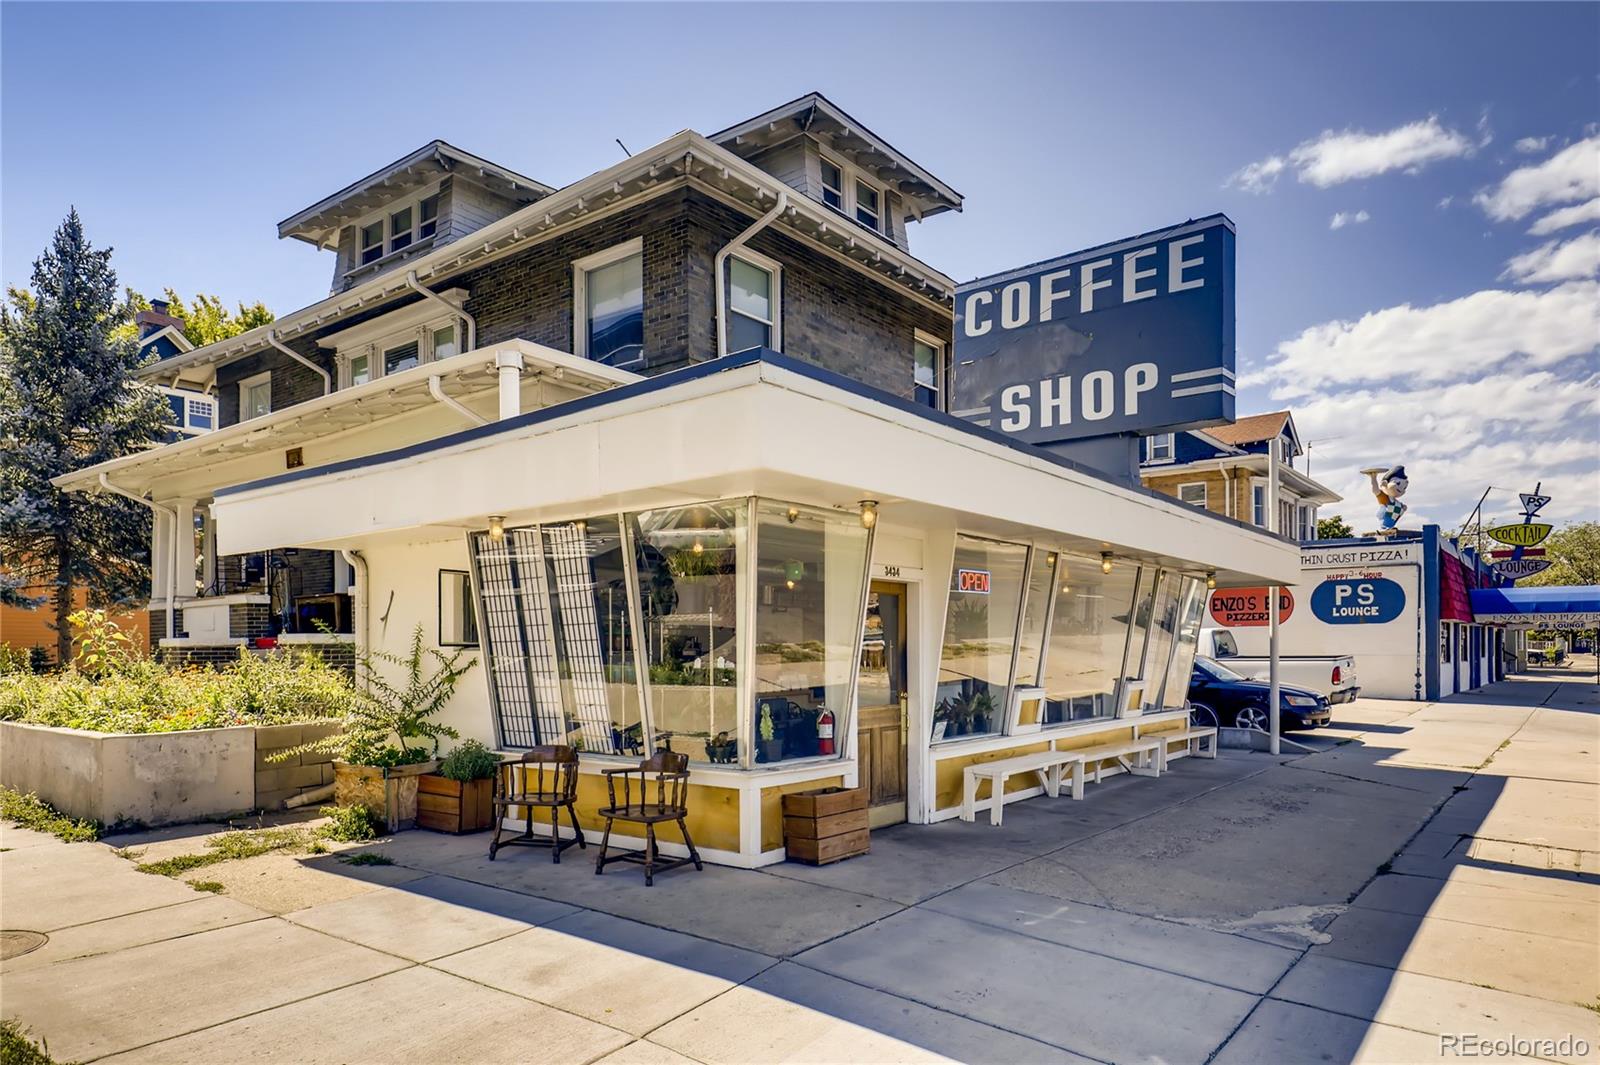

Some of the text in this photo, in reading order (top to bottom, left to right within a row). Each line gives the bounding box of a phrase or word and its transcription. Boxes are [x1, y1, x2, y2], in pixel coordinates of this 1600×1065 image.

[964, 234, 1205, 338] COFFEE
[1000, 362, 1159, 433] SHOP
[1526, 497, 1544, 507] PS
[1495, 526, 1542, 543] COCKTAIL
[1300, 549, 1408, 565] THIN CRUST PIZZA!
[1499, 561, 1541, 574] LOUNGE
[960, 572, 989, 592] OPEN
[1363, 571, 1383, 580] HOUR
[1212, 595, 1291, 612] ENZO'S ED
[1226, 612, 1270, 622] PIZZERI
[1332, 606, 1379, 617] LOUNGE
[1559, 613, 1600, 621] PIZZER
